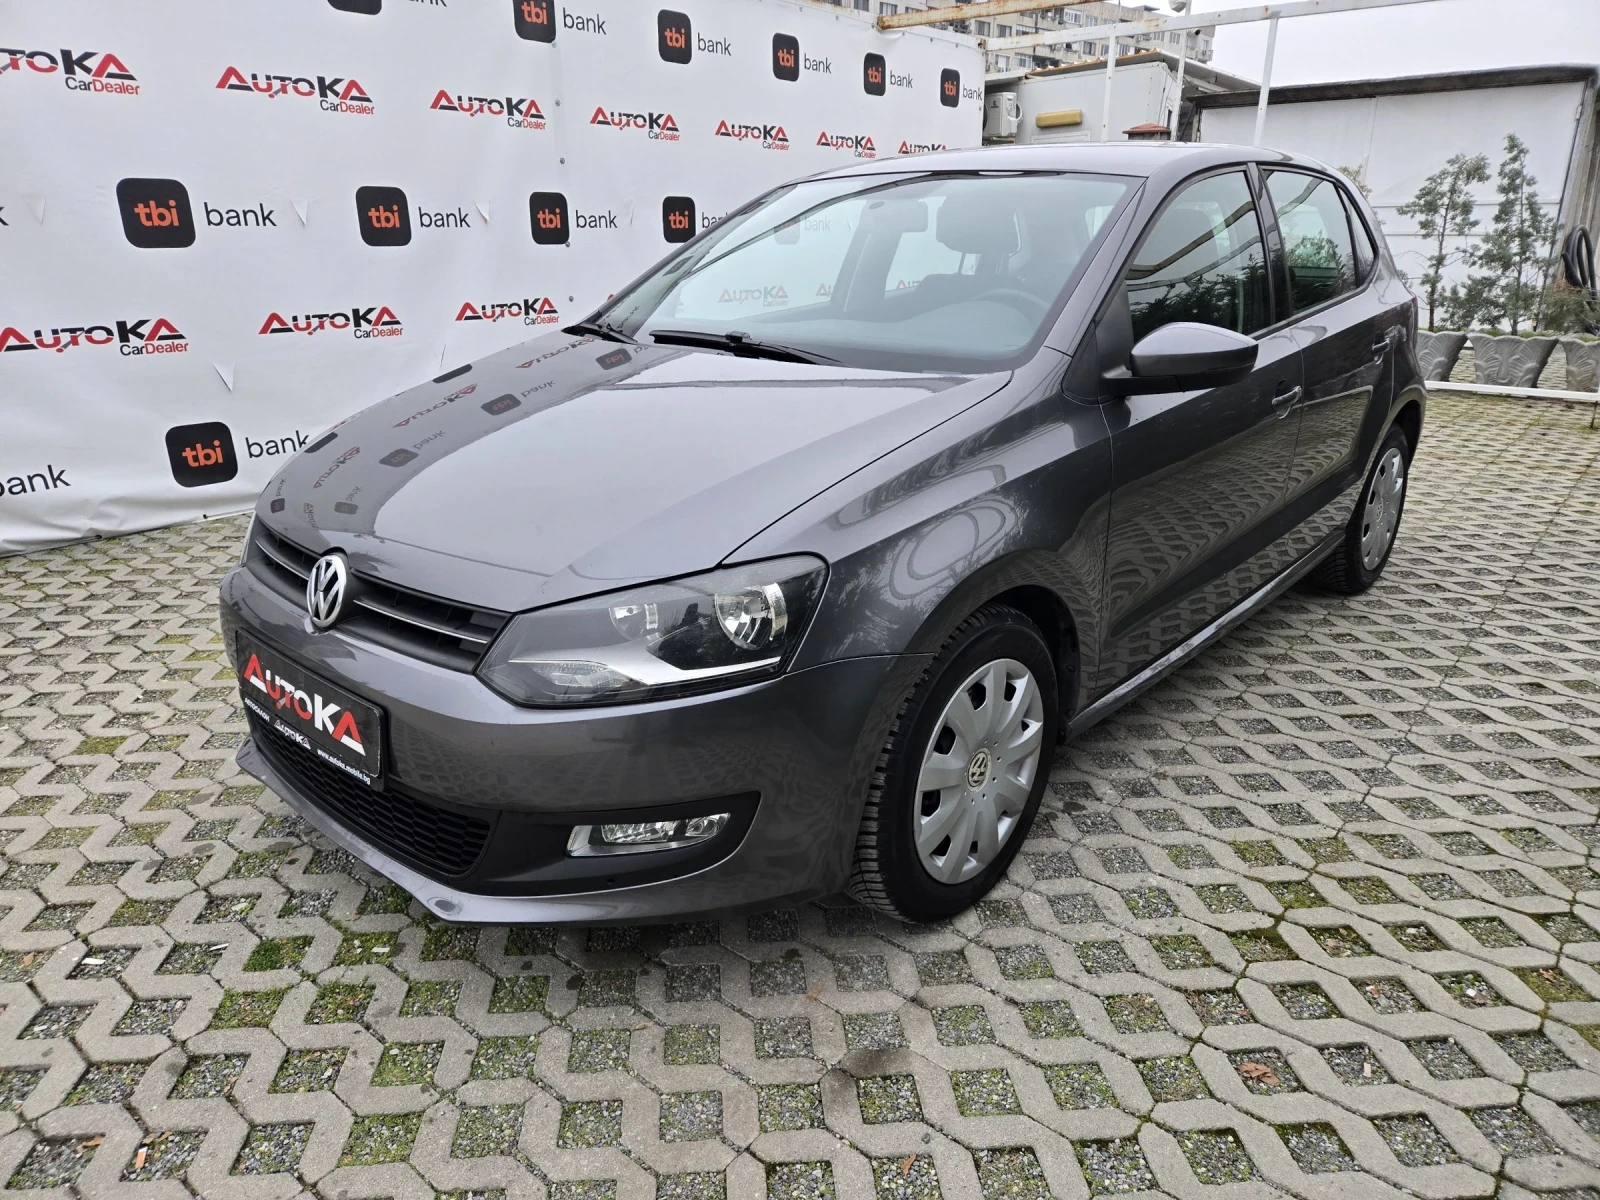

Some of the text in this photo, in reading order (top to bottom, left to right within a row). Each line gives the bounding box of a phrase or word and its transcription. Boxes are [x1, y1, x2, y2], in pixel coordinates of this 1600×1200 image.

[521, 0, 607, 35] tbi bank
[664, 27, 732, 56] tbi bank
[777, 49, 832, 74] tbi bank
[65, 76, 140, 95] CarDealer
[867, 67, 913, 88] tbi bank
[943, 80, 983, 101] tbi bank
[320, 99, 375, 115] CarDealer
[507, 117, 547, 130] CarDealer
[648, 130, 680, 142] CarDealer
[762, 140, 790, 151] CarDealer
[134, 199, 277, 227] tbi bank
[368, 205, 471, 228] tbi bank
[537, 209, 618, 229] tbi bank
[668, 210, 689, 229] tbi
[524, 315, 560, 326] CarDealer
[354, 327, 404, 339] CarDealer
[119, 342, 189, 356] CarDealer
[182, 440, 224, 467] tbi
